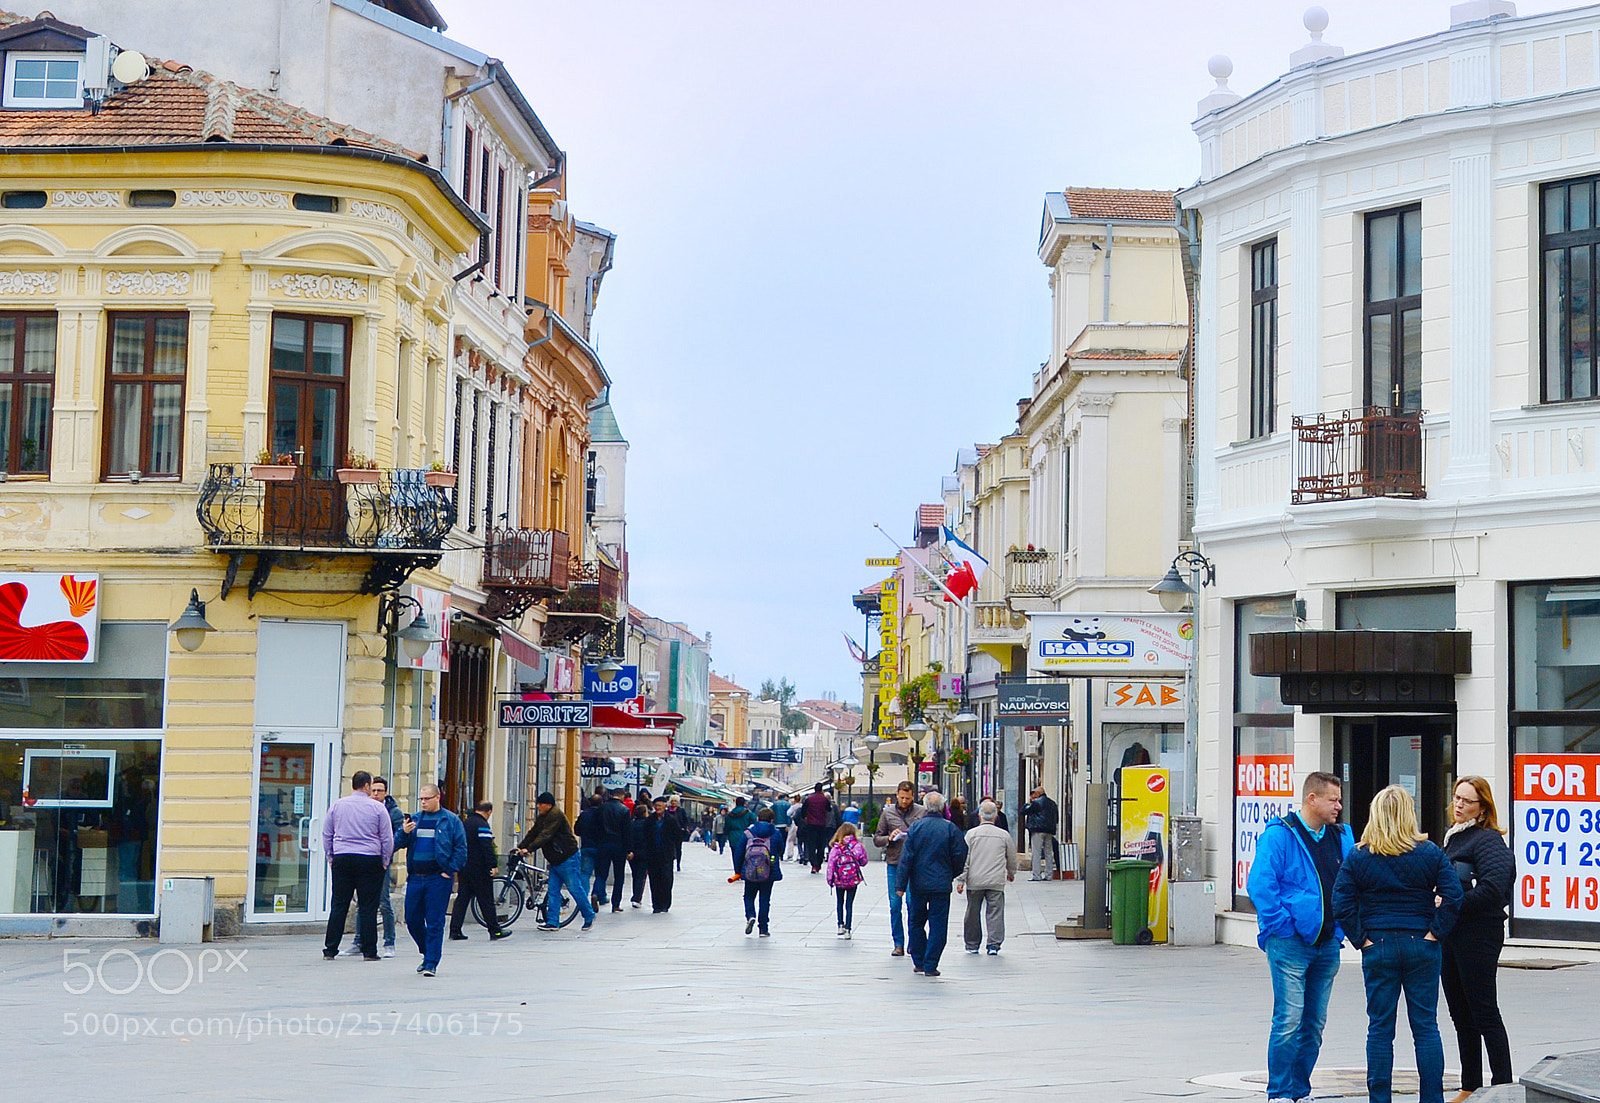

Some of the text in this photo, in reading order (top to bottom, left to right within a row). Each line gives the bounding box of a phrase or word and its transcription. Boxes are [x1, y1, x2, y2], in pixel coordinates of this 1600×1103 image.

[591, 681, 618, 693] NLB
[1114, 684, 1181, 706] SAB
[502, 705, 588, 724] MORITZ
[1000, 702, 1069, 710] NAUMOVSKI
[687, 747, 715, 756] BOND
[1238, 763, 1266, 791] FOR
[1523, 764, 1586, 796] FOR
[1240, 802, 1260, 824] 070
[1526, 808, 1571, 833] 070
[1123, 840, 1156, 849] German
[1526, 841, 1567, 865] 071
[1521, 874, 1550, 908] СЕ
